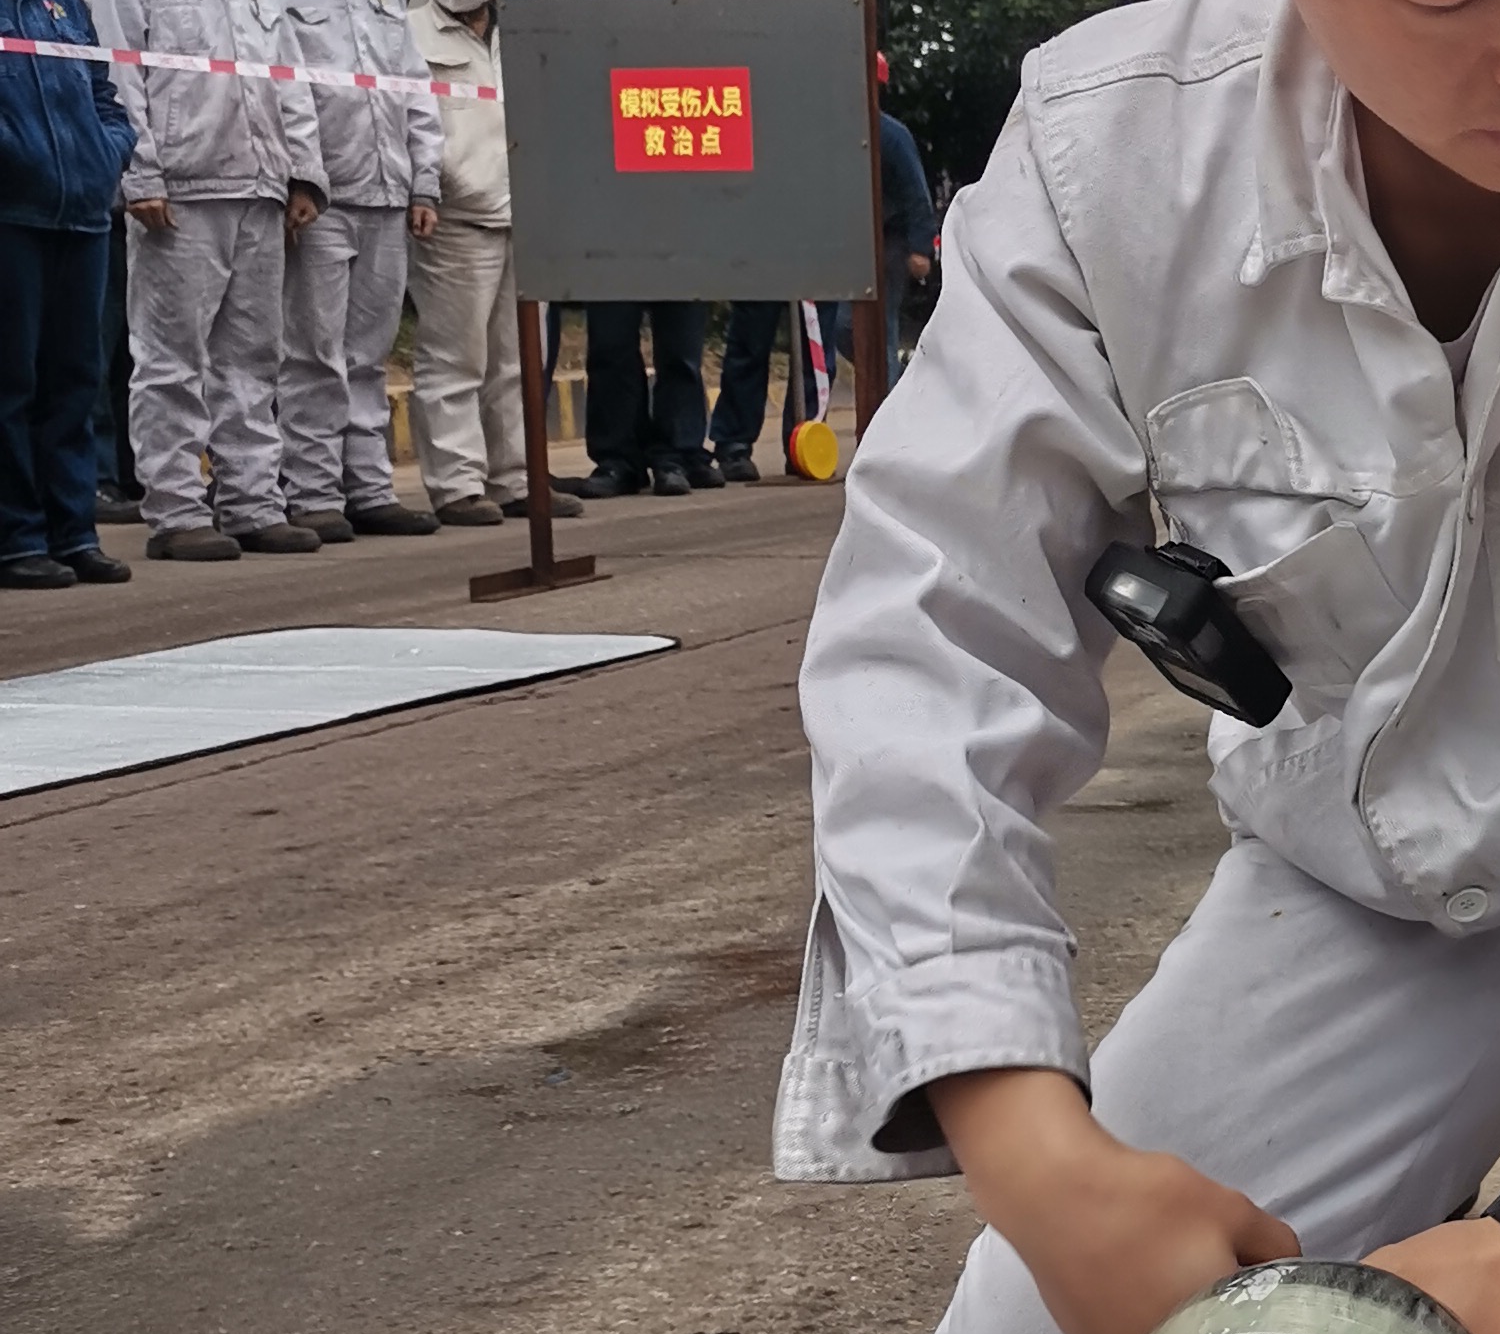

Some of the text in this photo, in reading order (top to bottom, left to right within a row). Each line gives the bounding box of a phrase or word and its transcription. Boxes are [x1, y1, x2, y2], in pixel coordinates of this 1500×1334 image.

[619, 86, 742, 119] 模拟受伤人员
[644, 125, 722, 157] 救治点
